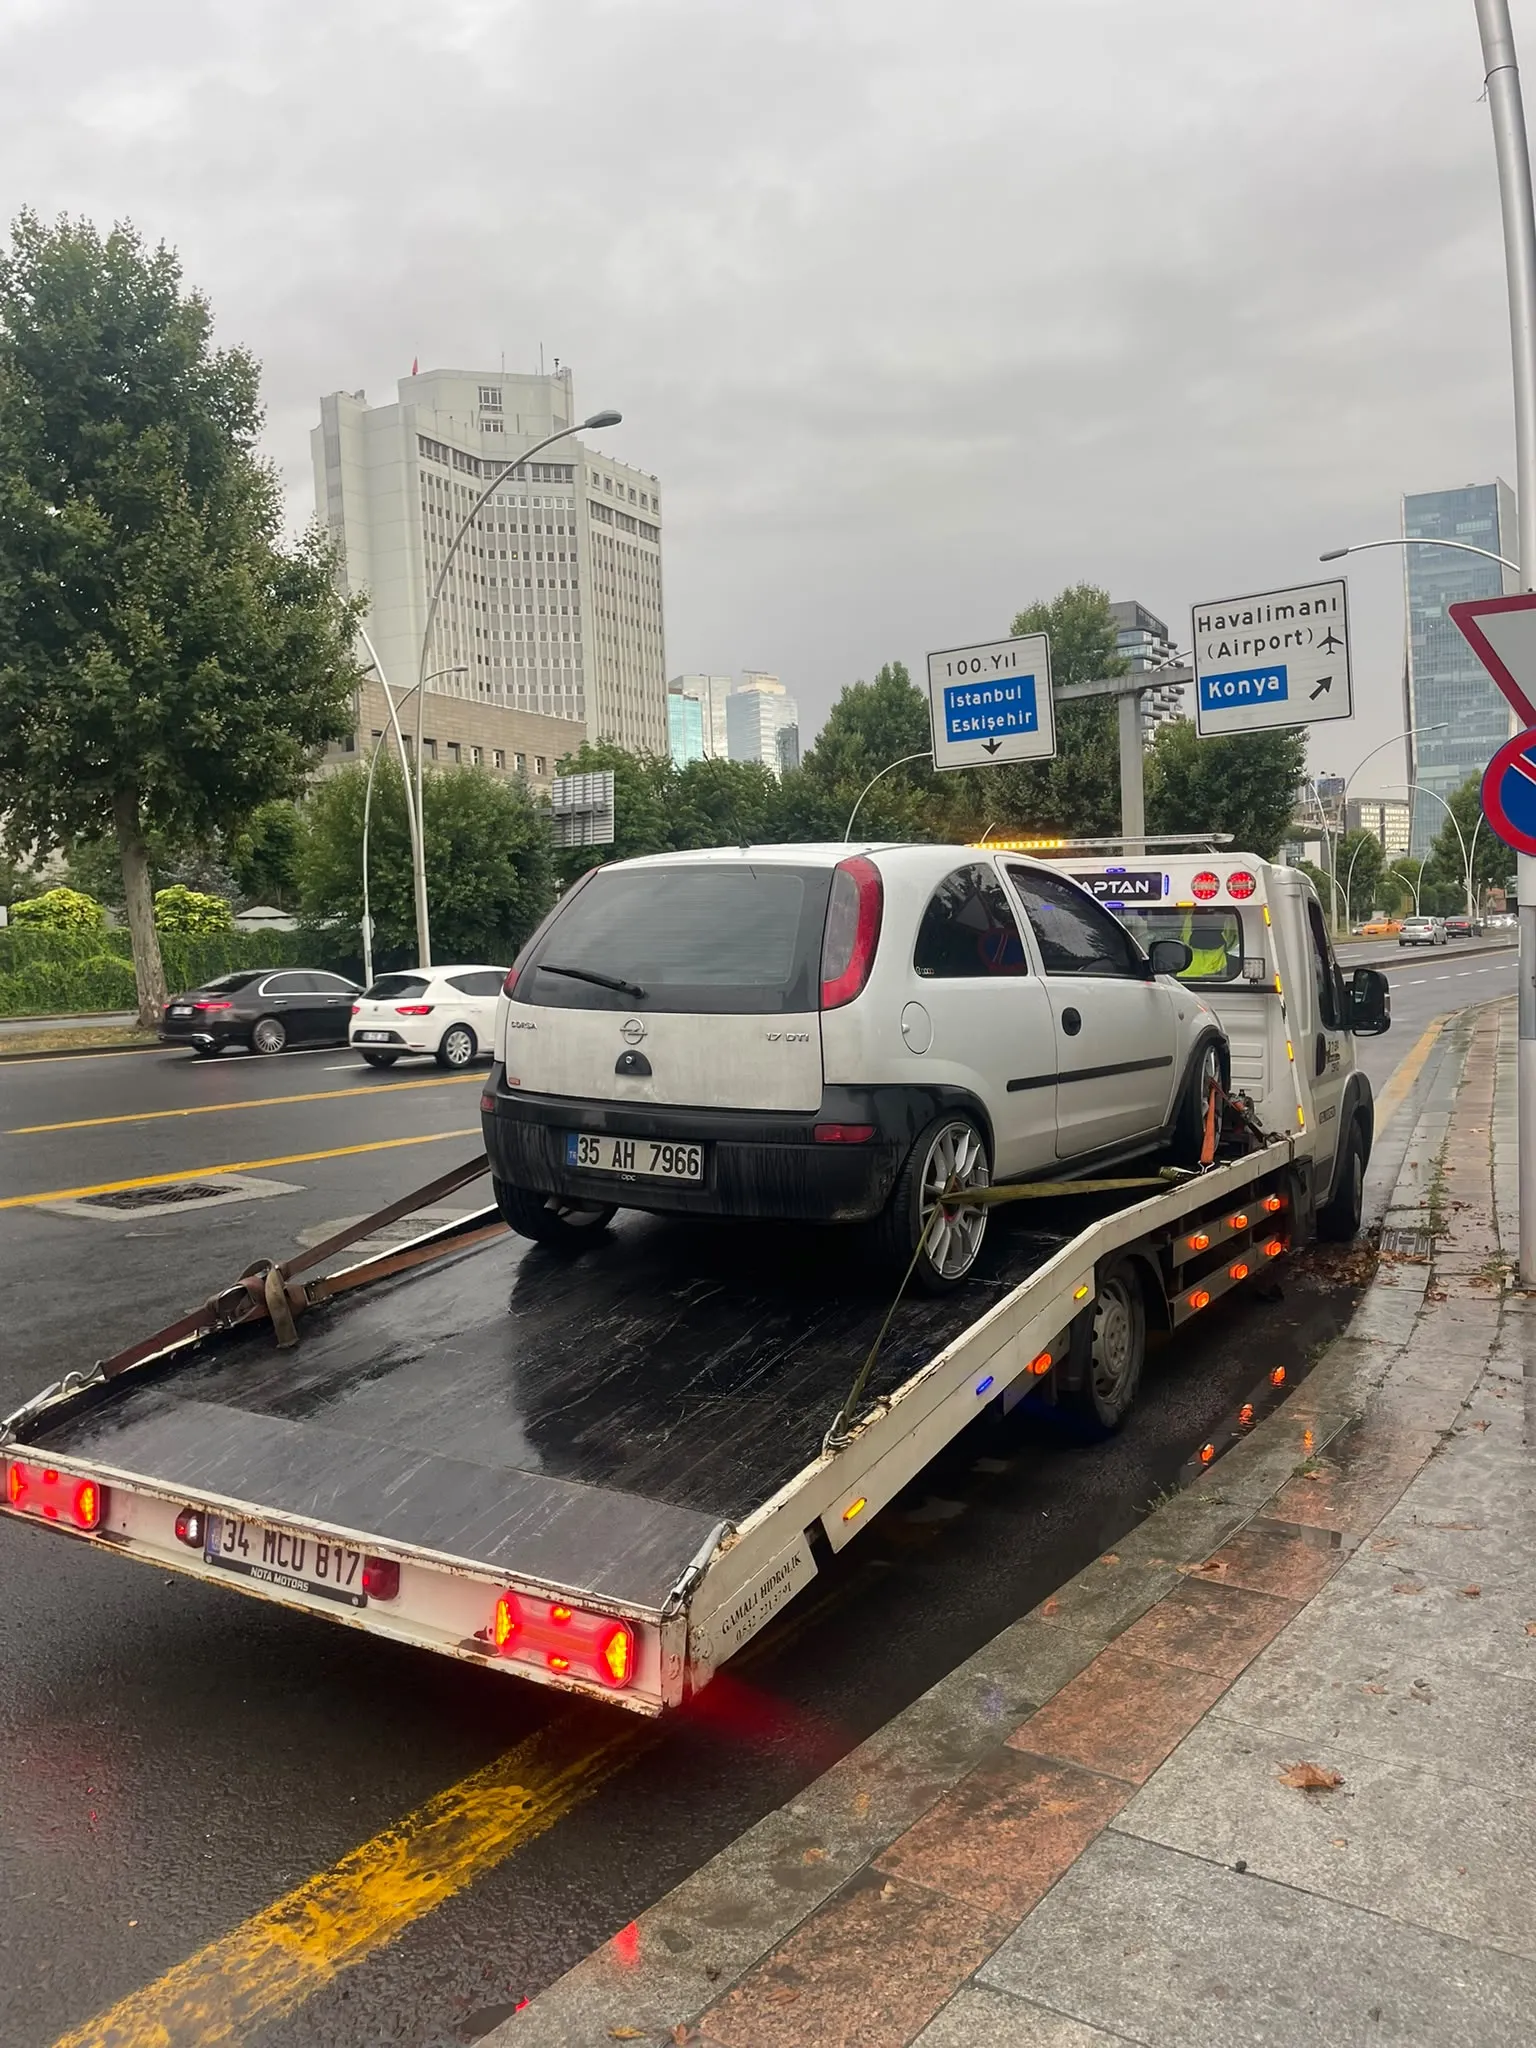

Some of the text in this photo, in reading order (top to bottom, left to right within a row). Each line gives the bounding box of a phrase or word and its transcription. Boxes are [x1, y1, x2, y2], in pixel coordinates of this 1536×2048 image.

[1197, 596, 1338, 633] Havalimanı
[1206, 627, 1314, 660] (Airport)
[949, 683, 1023, 709] İstanbul
[1208, 673, 1281, 700] Konya
[951, 710, 1033, 734] Eskişehir
[1079, 879, 1149, 894] APTAN
[578, 1136, 600, 1166] 35
[611, 1140, 636, 1170] AH
[648, 1144, 700, 1176] 7966
[223, 1519, 250, 1557] 34
[262, 1529, 306, 1572] MCU
[315, 1543, 361, 1586] 817
[250, 1566, 310, 1592] NOTA MOTORS
